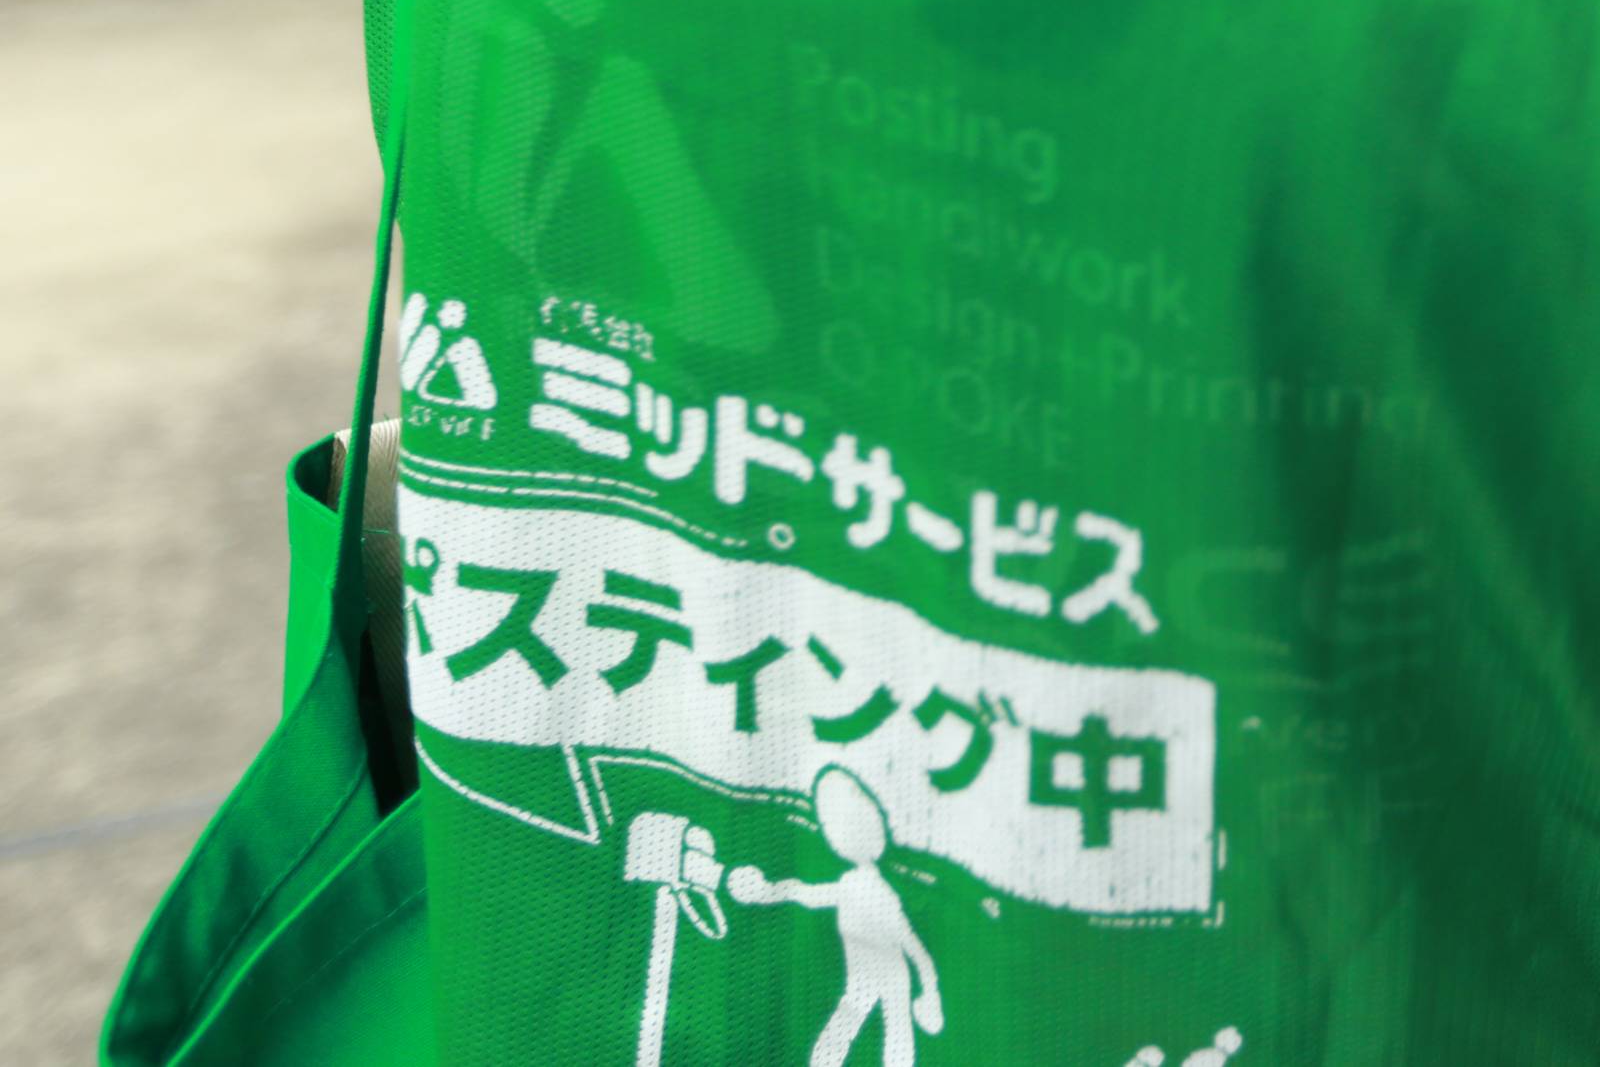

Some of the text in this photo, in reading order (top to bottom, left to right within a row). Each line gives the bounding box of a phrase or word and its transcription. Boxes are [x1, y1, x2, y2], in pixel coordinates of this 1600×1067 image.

[529, 336, 1160, 634] ミッドサービス
